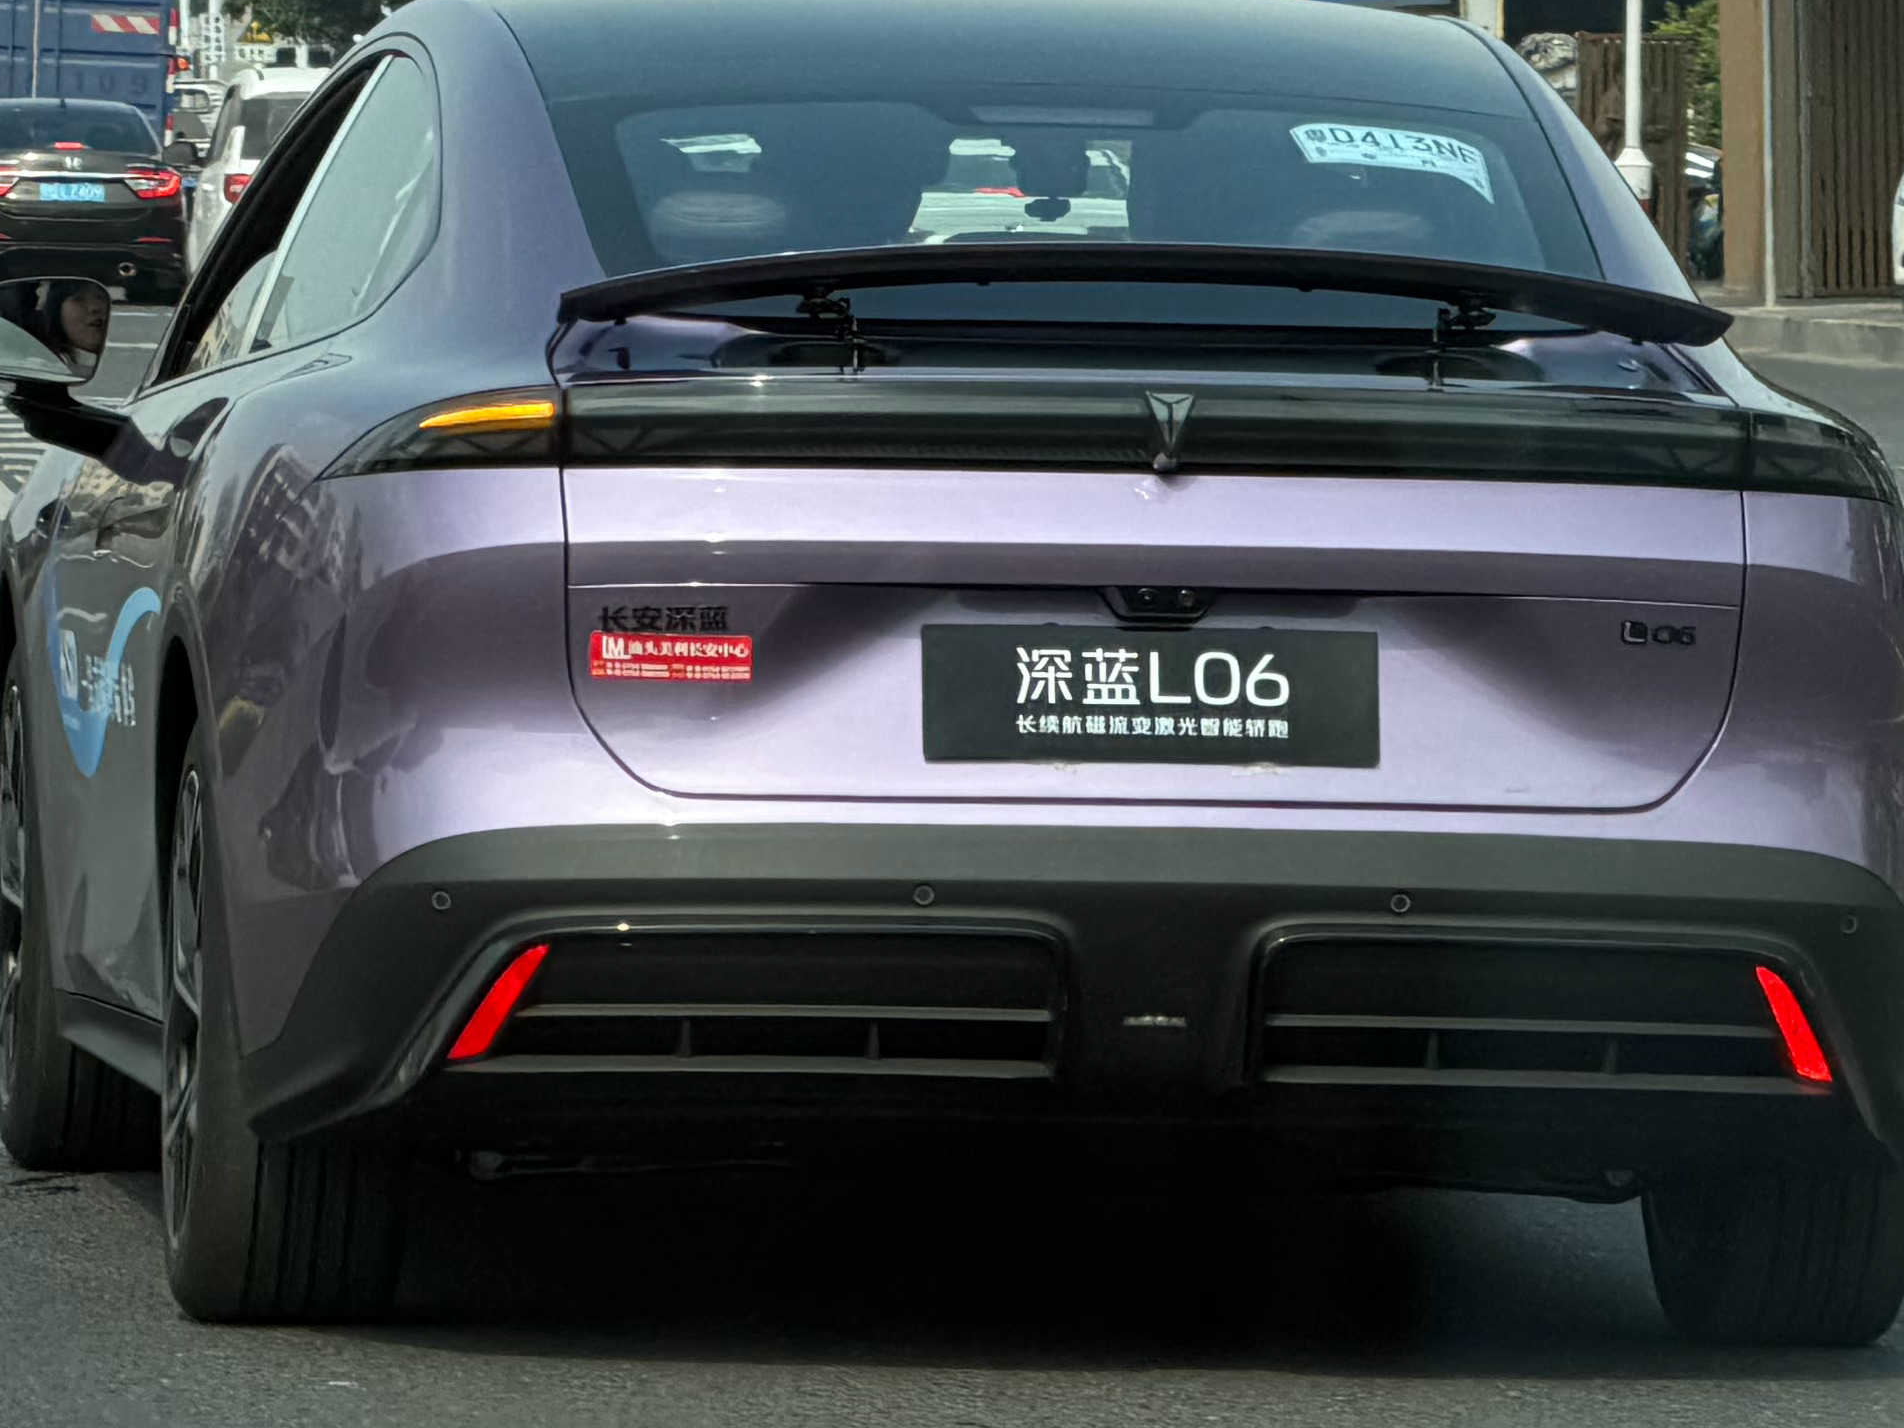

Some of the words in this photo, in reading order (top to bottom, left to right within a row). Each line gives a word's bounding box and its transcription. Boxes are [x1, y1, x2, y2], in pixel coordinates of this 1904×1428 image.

[598, 606, 729, 632] 长安深蓝
[1015, 647, 1290, 707] 深蓝L06
